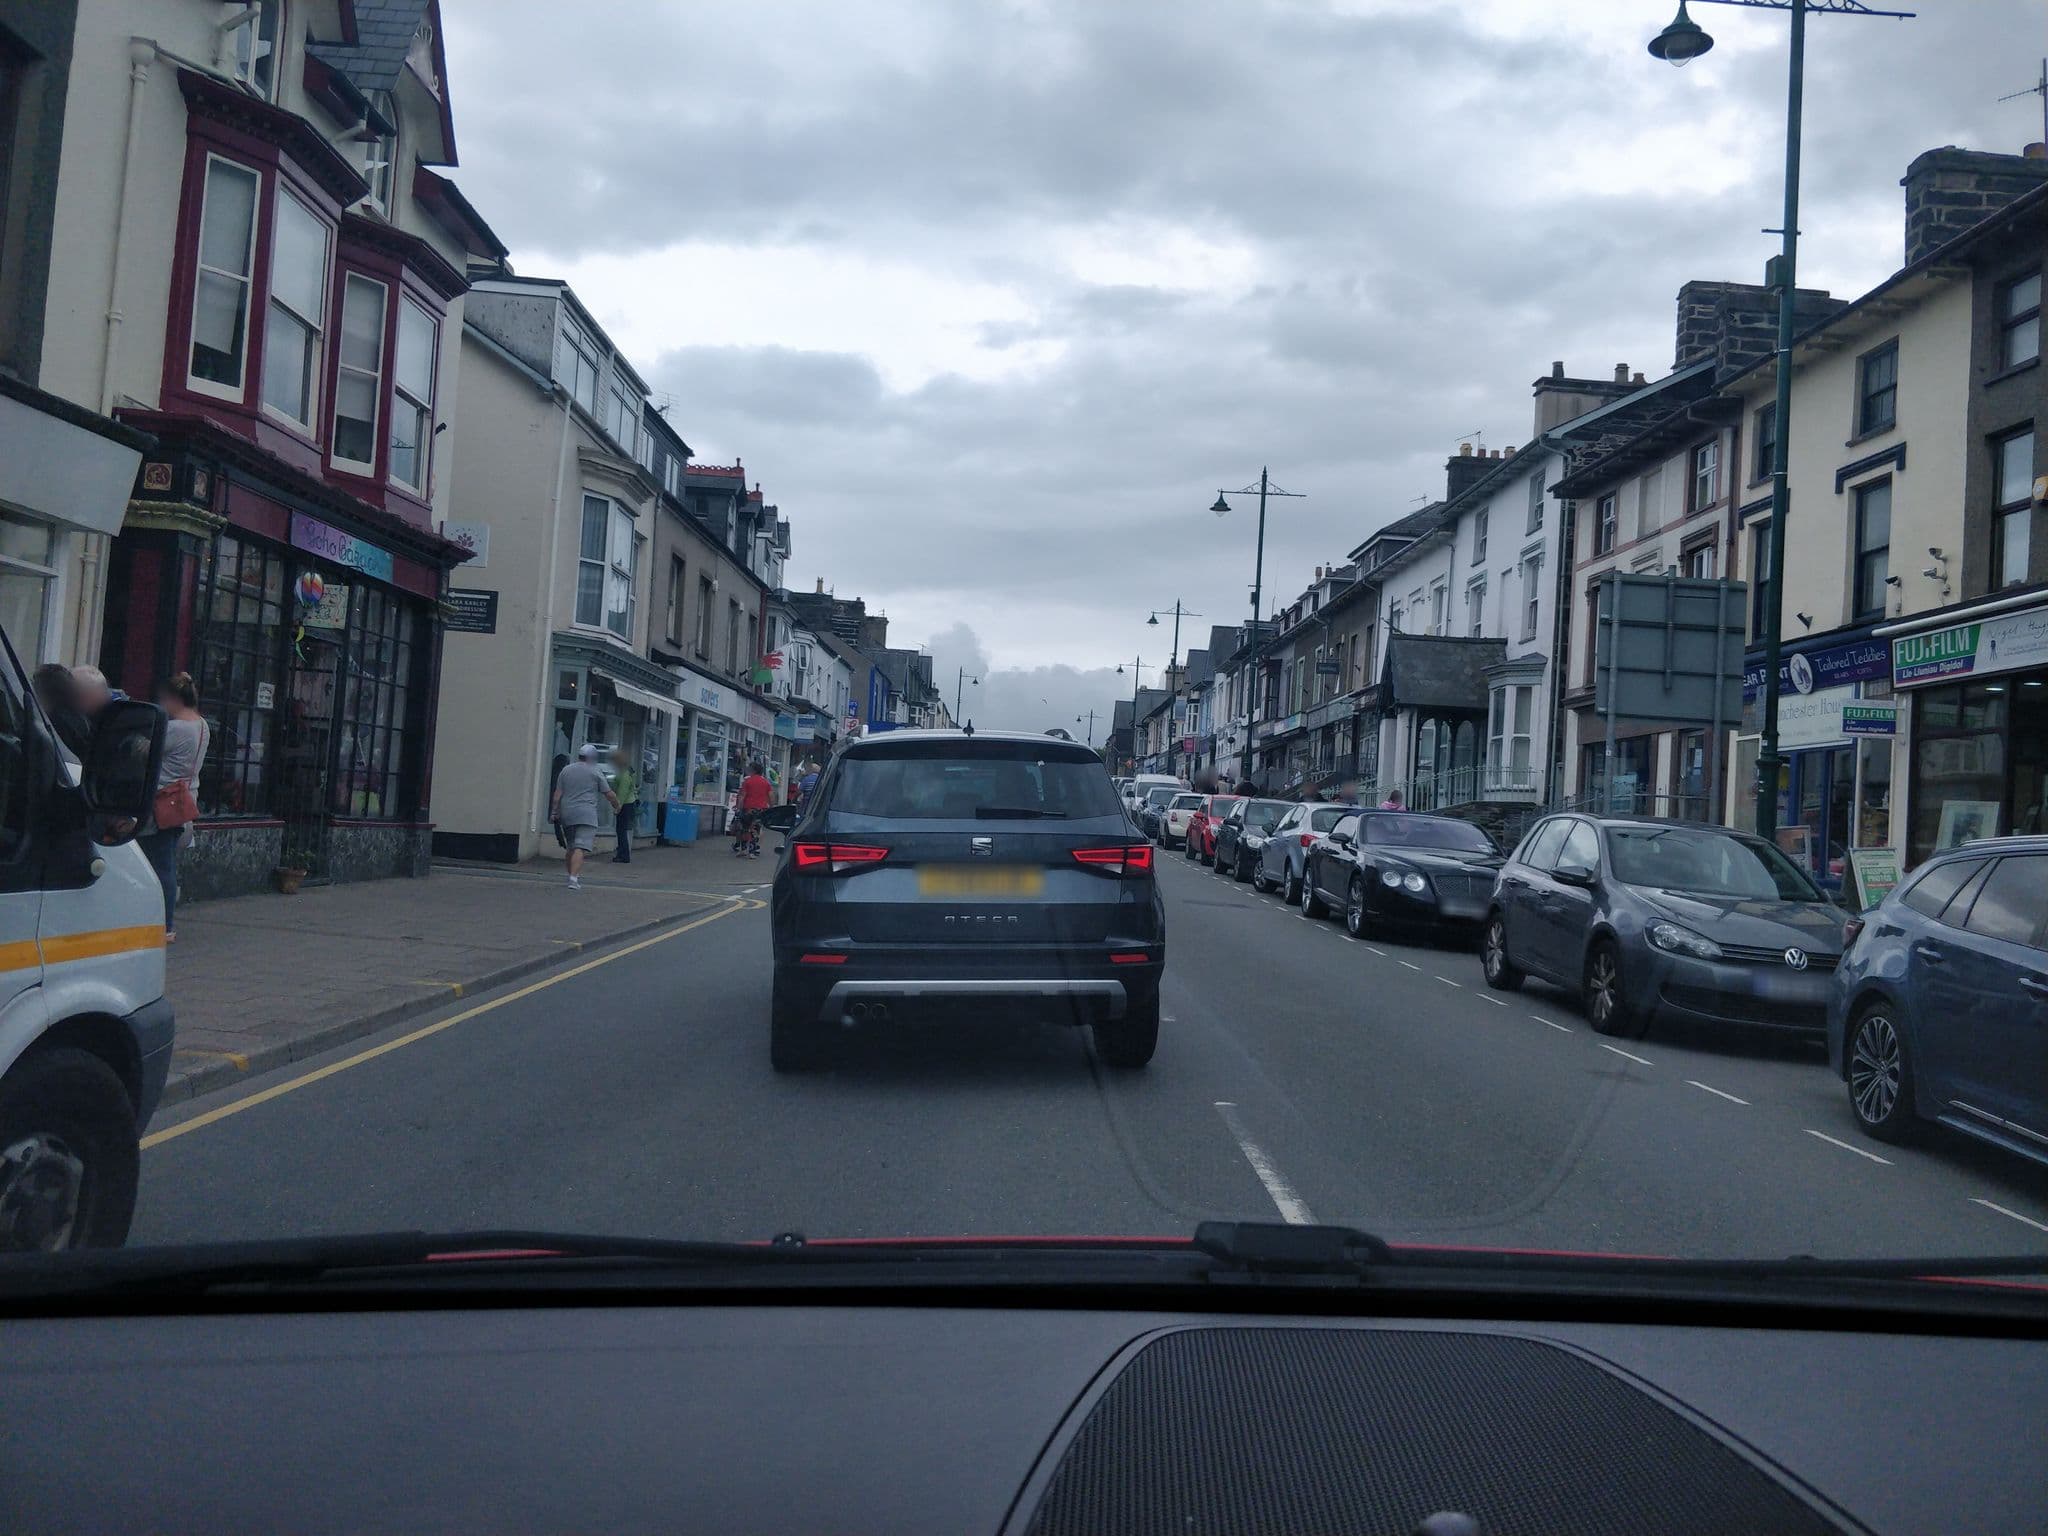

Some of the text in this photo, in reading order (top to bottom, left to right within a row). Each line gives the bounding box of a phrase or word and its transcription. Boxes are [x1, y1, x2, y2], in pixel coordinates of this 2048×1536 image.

[1815, 646, 1887, 673] Tailored Teddies
[1743, 673, 1759, 687] EAR
